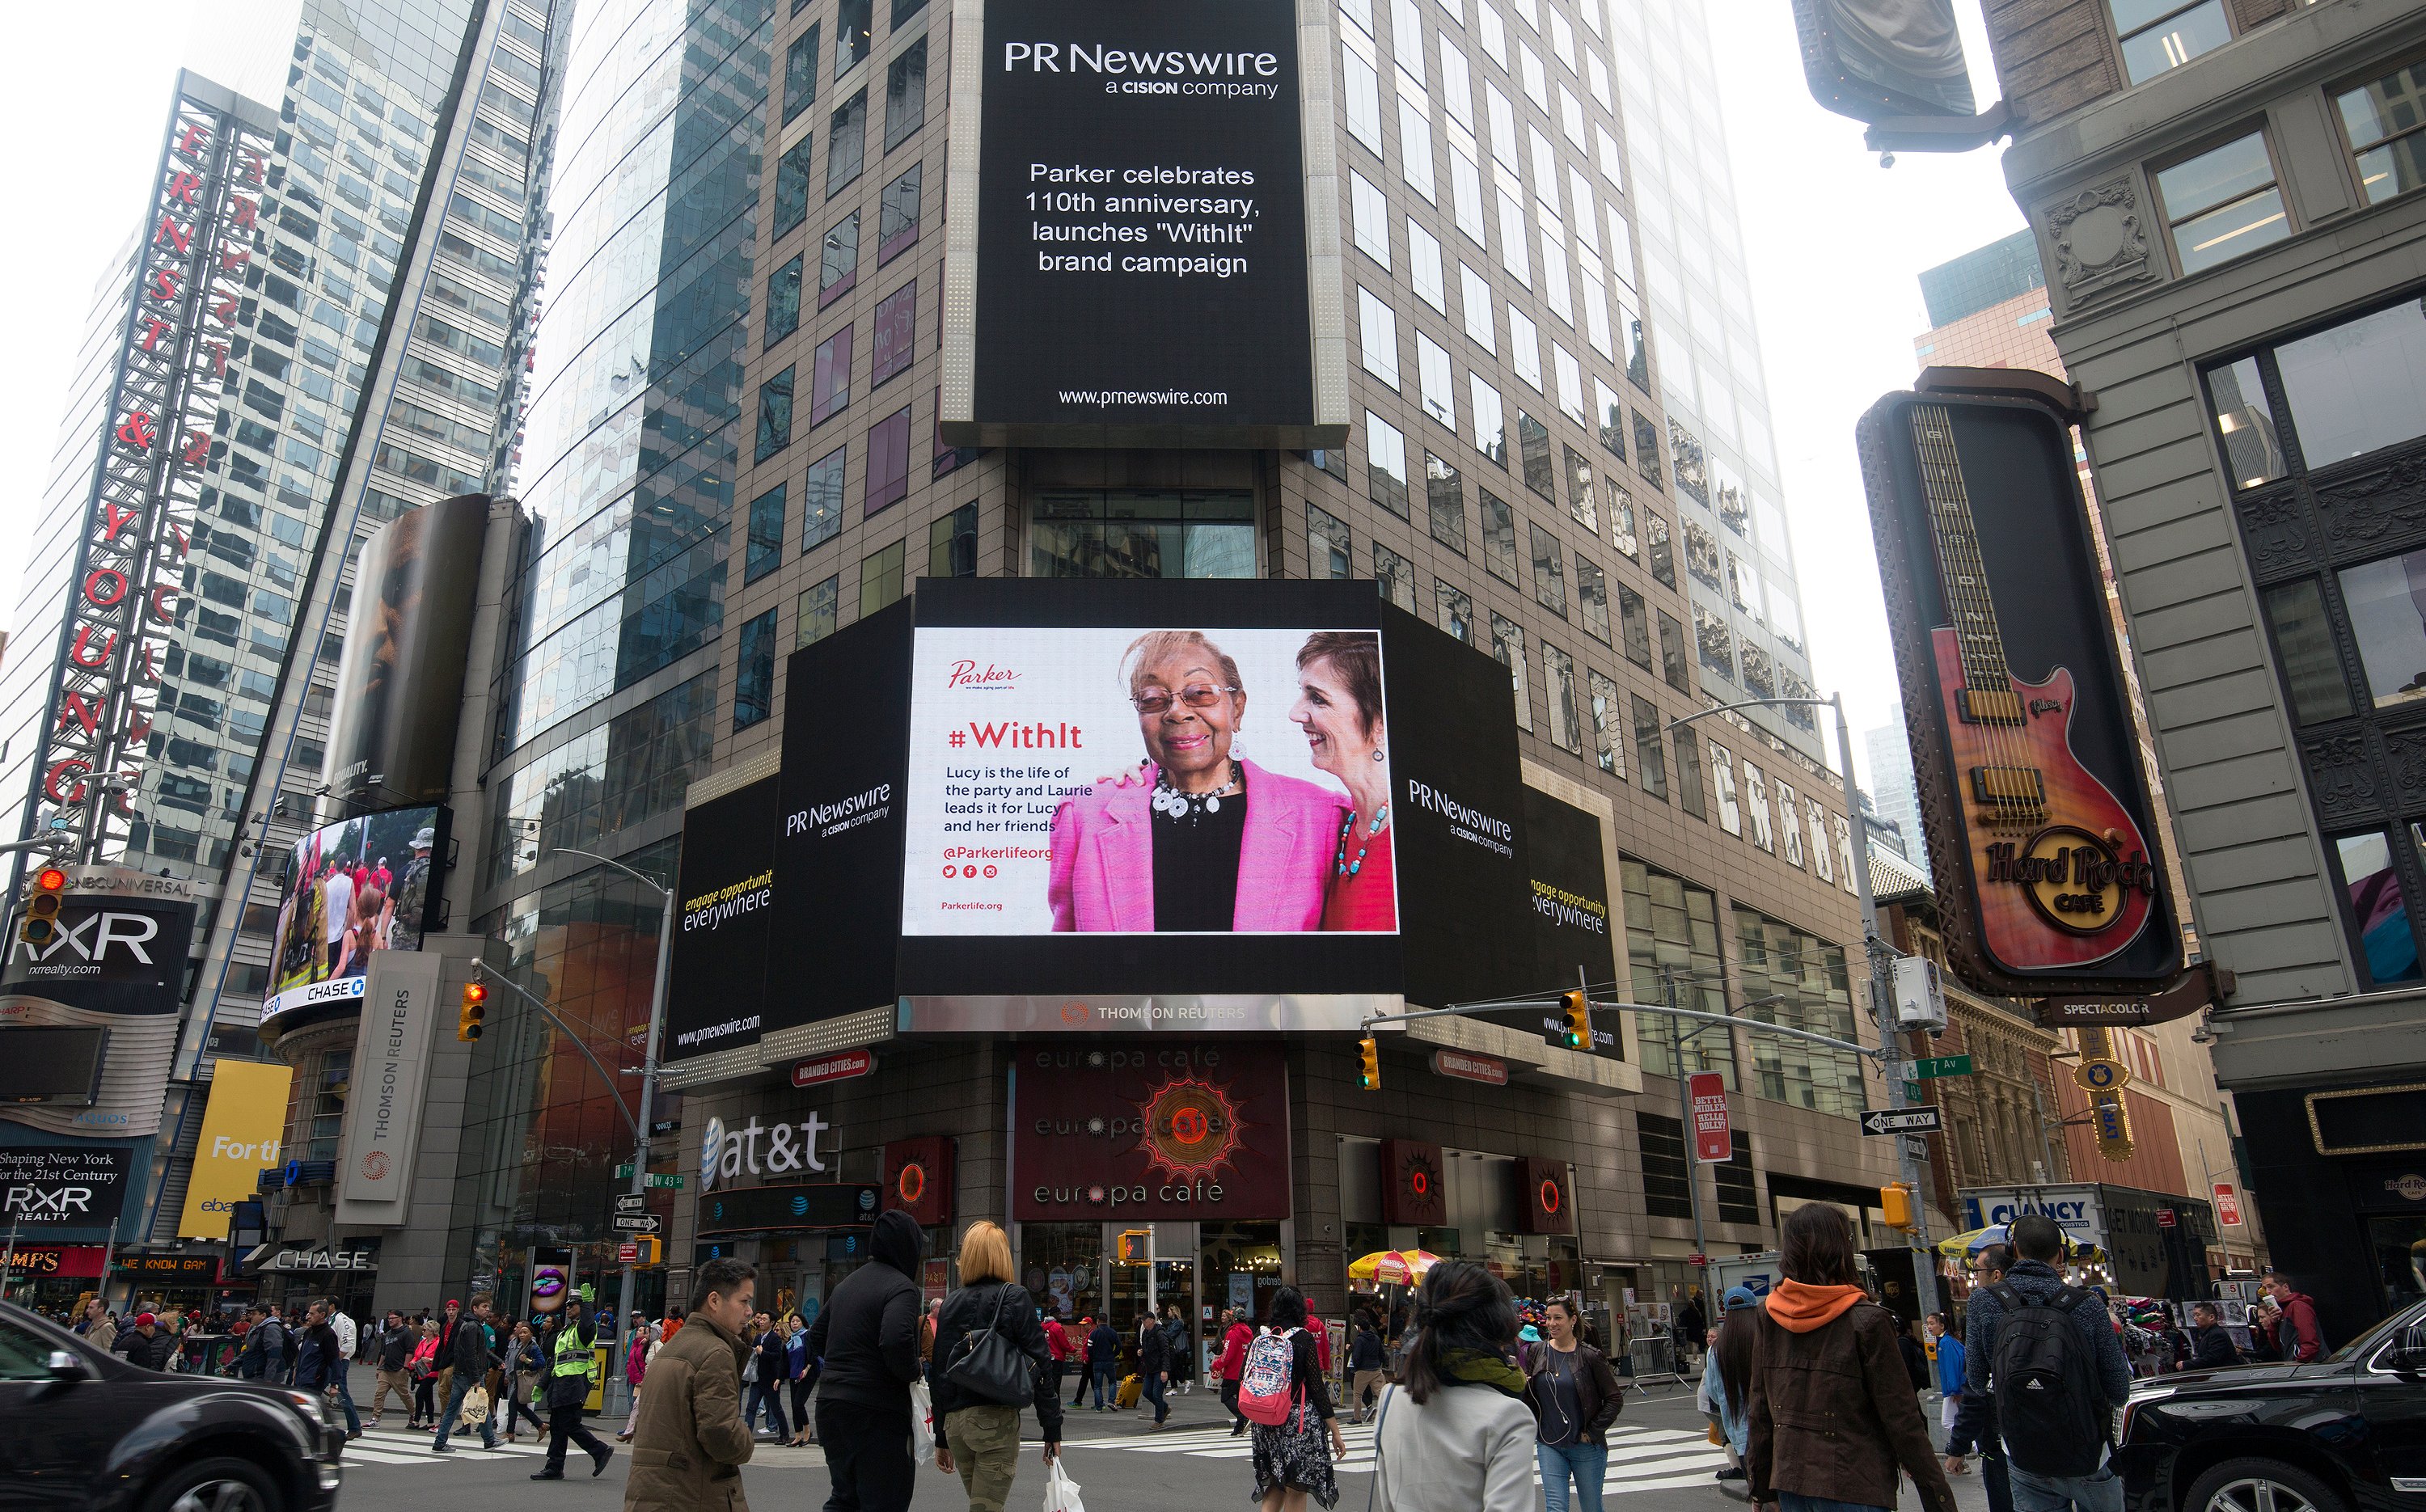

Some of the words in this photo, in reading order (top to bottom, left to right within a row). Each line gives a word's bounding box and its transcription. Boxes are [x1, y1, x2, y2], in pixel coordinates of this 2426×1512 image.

[1005, 42, 1061, 73] PR
[1069, 44, 1279, 76] Newswire
[1105, 82, 1118, 94] a
[1122, 82, 1178, 95] CISION
[1182, 82, 1279, 99] company
[1030, 163, 1115, 183] Parker
[1122, 165, 1255, 185] celebrates
[1026, 192, 1096, 212] 110th
[1105, 193, 1260, 218] anniversary,
[144, 123, 208, 352] ERNST
[1033, 222, 1147, 242] launches
[1156, 222, 1253, 243] "WithIt"
[1039, 251, 1112, 272] brand
[1122, 253, 1248, 278] campaign
[1059, 388, 1228, 409] www.prnewswire.com
[45, 503, 137, 805] YOUNG
[948, 660, 1023, 688] Parker
[948, 721, 1083, 749] #WithIt
[946, 767, 980, 781] Lucy
[985, 767, 996, 779] is
[1000, 767, 1023, 779] the
[1027, 767, 1050, 779] life
[1054, 767, 1070, 779] of
[945, 784, 970, 796] the
[974, 785, 1012, 799] party
[1015, 784, 1042, 796] and
[1047, 784, 1093, 796] Laurie
[786, 810, 807, 837] PR
[809, 783, 890, 829] Newswire
[945, 802, 984, 814] leads
[987, 802, 997, 814] it
[1001, 802, 1023, 814] for
[1026, 802, 1062, 817] Lucy
[1409, 779, 1433, 810] PR
[1434, 788, 1511, 842] Newswire
[822, 828, 827, 838] a
[827, 820, 850, 835] CISION
[850, 805, 890, 827] company
[944, 820, 972, 832] and
[976, 820, 1000, 832] her
[1004, 820, 1056, 832] friends
[1450, 824, 1456, 834] a
[1456, 826, 1478, 843] CISION
[1477, 835, 1513, 859] company
[943, 847, 1055, 862] @Parkerlifeorg
[1986, 842, 2070, 883] Hard
[2071, 846, 2155, 895] Rock
[72, 876, 192, 897] NBCUNIVERSAL
[685, 890, 719, 913] engage
[719, 868, 773, 901] opportunit
[941, 902, 1003, 911] Parkerlife.org
[1530, 878, 1557, 900] ngage
[1558, 889, 1606, 919] opportunity
[2053, 893, 2106, 914] CAFE
[684, 888, 771, 931] everywhere
[1532, 895, 1604, 934] verywhere
[28, 963, 101, 978] rxrrealty.com
[307, 982, 350, 1001] CHASE
[1098, 1007, 1174, 1020] THOMSON
[1178, 1007, 1246, 1020] REUTERS
[2063, 1003, 2150, 1016] SPECTACOLOR
[678, 1014, 760, 1046] www.prnewswire.com
[374, 1062, 398, 1141] THOMSON
[387, 989, 409, 1058] REUTERS
[1157, 1045, 1220, 1068] café
[1443, 1054, 1472, 1072] BRANDED
[799, 1062, 829, 1080] BRANDED
[830, 1058, 865, 1074] CITIES.com
[1930, 1061, 1938, 1075] 7
[1693, 1103, 1727, 1113] MIDLER
[1694, 1095, 1724, 1105] BETTE
[75, 1113, 128, 1125] AQUOS
[1697, 1113, 1727, 1122] HELLO,
[1698, 1121, 1727, 1131] DOLLY!
[1873, 1117, 1896, 1129] ONE
[1905, 1114, 1930, 1126] WAY
[212, 1135, 256, 1160] For
[721, 1111, 829, 1179] at&t
[0, 1152, 44, 1168] Shaping
[49, 1153, 79, 1165] New
[83, 1153, 113, 1166] York
[14, 1168, 32, 1180] the
[34, 1168, 60, 1180] 21st
[63, 1169, 118, 1185] Century
[654, 1176, 662, 1186] W
[664, 1176, 674, 1187] 43
[2384, 1180, 2411, 1190] Hard
[4, 1187, 92, 1212] RXR
[1034, 1180, 1147, 1208] europa
[1159, 1178, 1224, 1202] café
[201, 1198, 234, 1213] eba
[619, 1200, 628, 1208] ONE
[1991, 1202, 2086, 1225] CLANCY
[17, 1213, 71, 1221] REALTY
[619, 1218, 634, 1227] ONE
[859, 1212, 875, 1223] at&t
[2109, 1208, 2126, 1233] GET
[2129, 1209, 2161, 1236] MOVING
[275, 1251, 370, 1270] CHASE
[1944, 1248, 1962, 1256] SABRETT
[145, 1259, 177, 1270] KNOW
[184, 1260, 207, 1270] GAM
[1886, 1286, 1900, 1297] ups
[2229, 1284, 2237, 1293] 5
[1204, 1307, 1211, 1316] A
